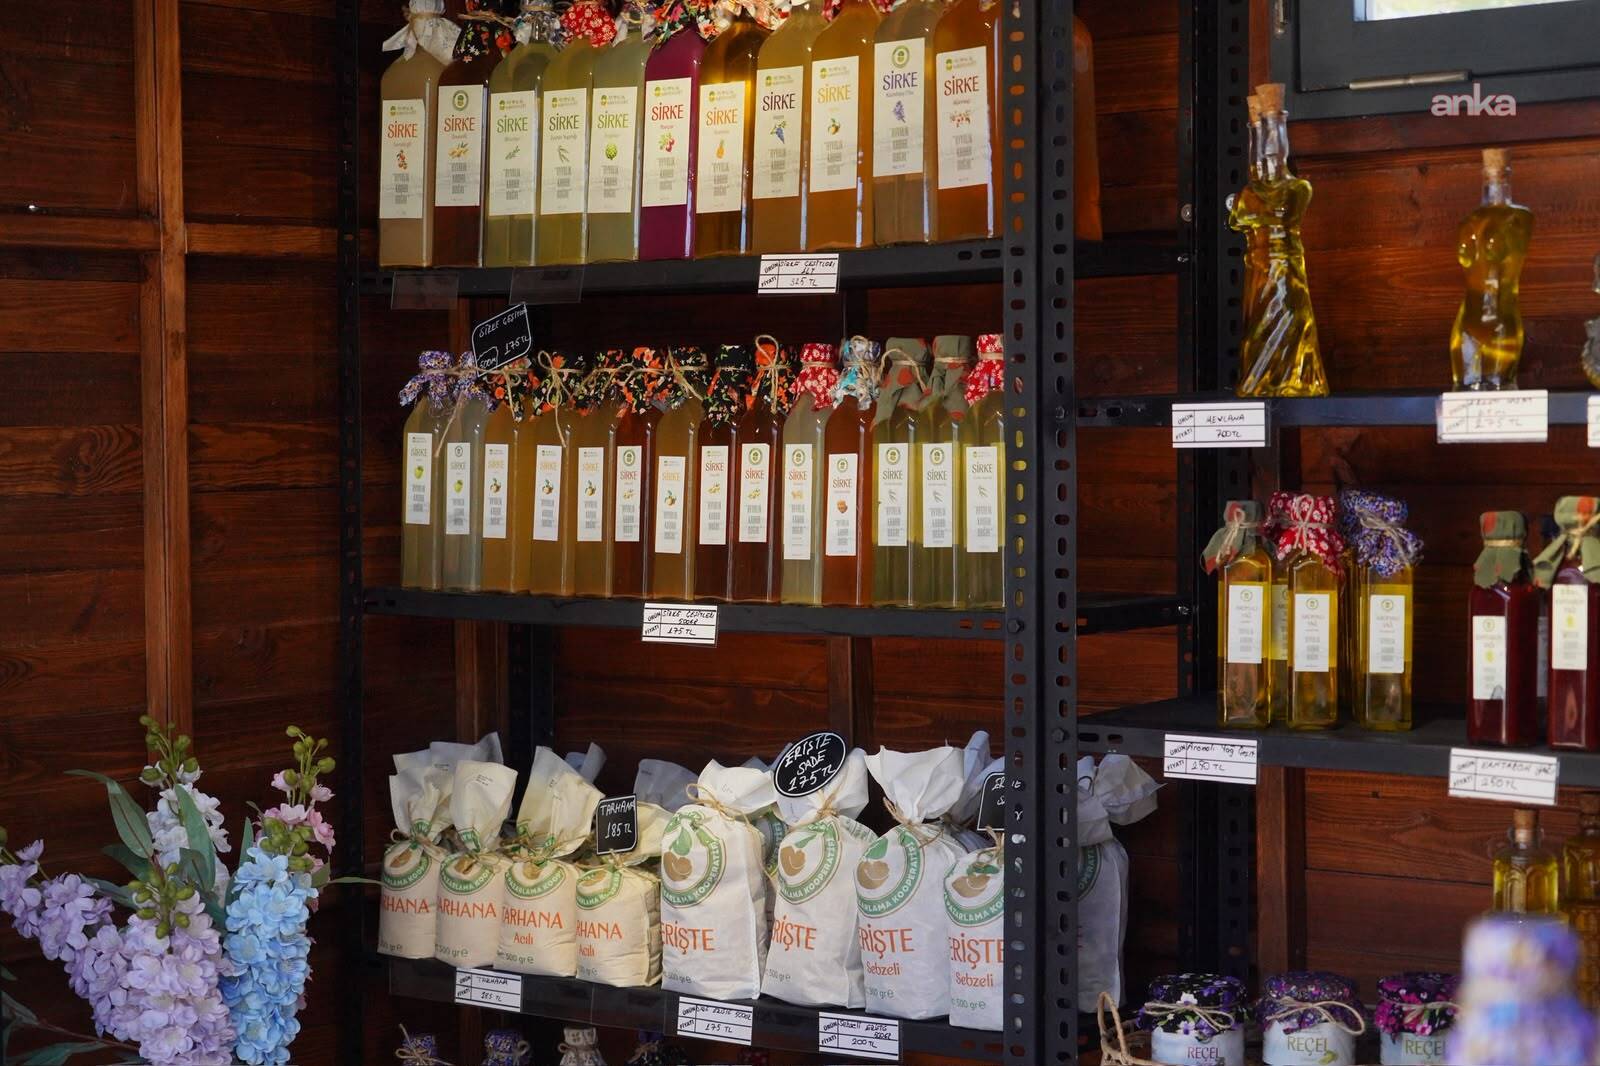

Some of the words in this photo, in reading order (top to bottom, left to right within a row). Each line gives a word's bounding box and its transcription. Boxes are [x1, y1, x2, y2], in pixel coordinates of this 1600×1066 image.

[882, 70, 918, 90] SİRKE
[944, 76, 979, 96] SİRKE
[762, 92, 796, 112] SİRKE
[818, 84, 851, 104] SİRKE
[598, 111, 630, 128] SİRKE
[652, 102, 684, 121] SİRKE
[706, 107, 738, 126] SİRKE
[388, 121, 418, 138] SİRKE
[444, 115, 476, 132] SİRKE
[497, 115, 528, 133] SİRKE
[549, 113, 580, 131] SİRKE
[706, 460, 724, 472] SİRKE
[744, 468, 764, 480] SİRKE
[788, 469, 808, 480] SİRKE
[882, 468, 903, 480] SİRKE
[928, 468, 948, 480] SİRKE
[972, 462, 992, 474] SİRKE
[620, 470, 638, 480] SİRKE
[832, 477, 852, 488] SİRKE
[797, 749, 826, 776] SADE
[788, 768, 822, 792] 175
[822, 764, 836, 776] TL
[600, 800, 634, 816] TARHANA
[604, 822, 622, 839] 185
[772, 914, 817, 952] RİŞTE
[866, 961, 900, 976] Sebzeli
[956, 972, 994, 988] Sebzeli
[852, 1038, 867, 1046] 200
[1288, 1036, 1329, 1057] REÇEL
